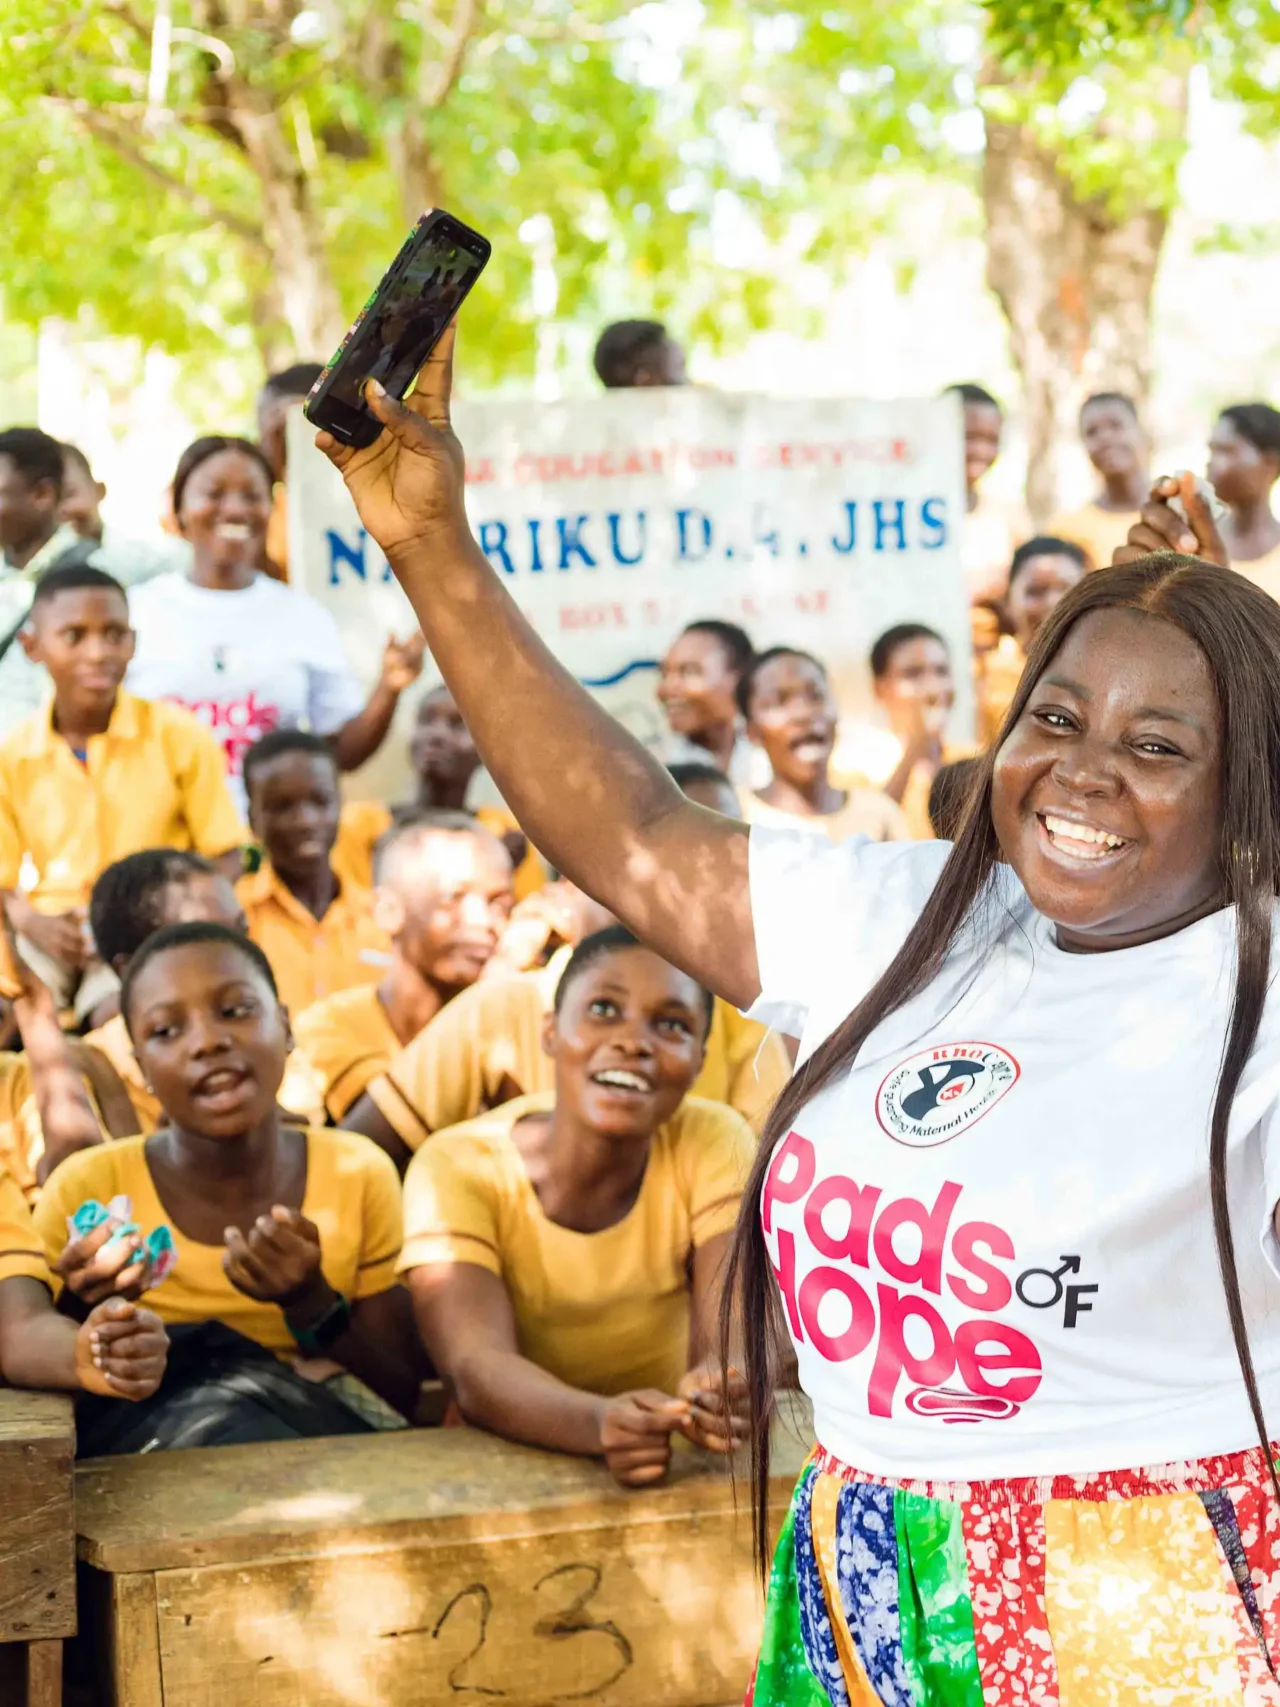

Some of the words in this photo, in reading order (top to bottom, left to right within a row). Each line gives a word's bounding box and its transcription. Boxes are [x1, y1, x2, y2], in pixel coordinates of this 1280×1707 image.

[324, 510, 647, 586] NRIKU
[832, 496, 947, 554] JHS
[909, 1113, 962, 1137] Maternal
[760, 1131, 1015, 1312] Pads
